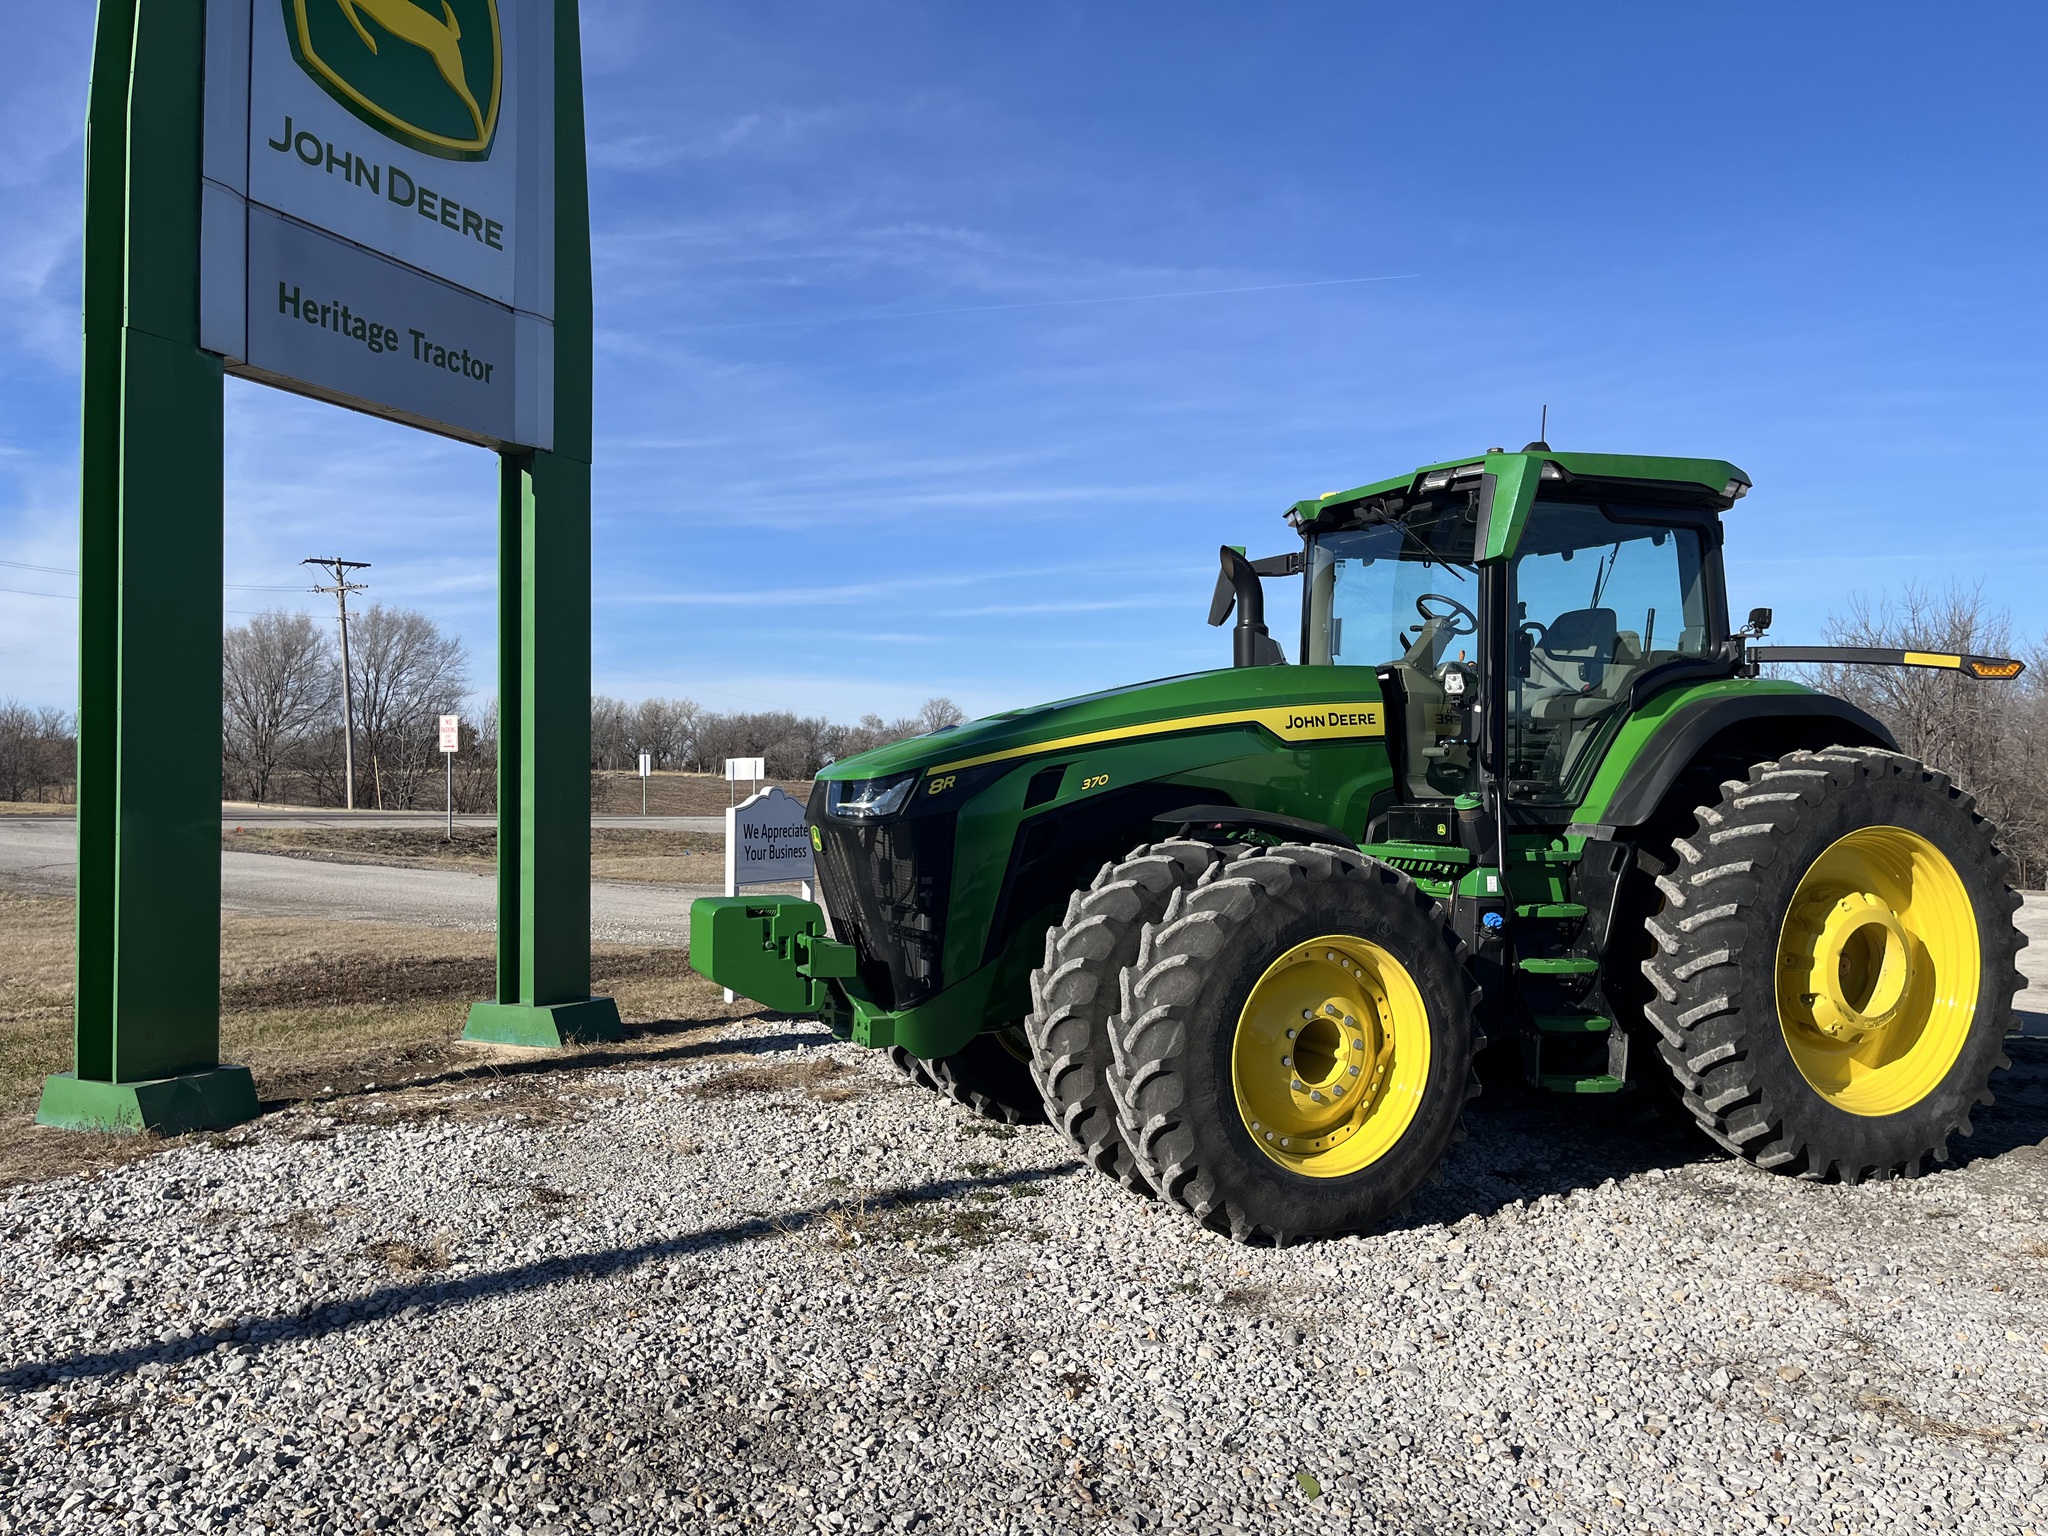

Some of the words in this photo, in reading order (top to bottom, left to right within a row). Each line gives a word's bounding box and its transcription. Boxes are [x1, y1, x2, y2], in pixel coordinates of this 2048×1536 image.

[268, 115, 380, 195] JOHN
[388, 165, 503, 251] DEERE
[278, 281, 399, 353] Heritage
[408, 328, 494, 384] Tractor
[1285, 714, 1325, 729] JOHN
[1328, 712, 1376, 726] DEERE
[927, 775, 956, 795] 8R
[1081, 773, 1110, 790] 370
[743, 824, 759, 839] We
[761, 823, 808, 843] Appreciate
[744, 845, 767, 861] Your
[769, 844, 807, 859] Business
